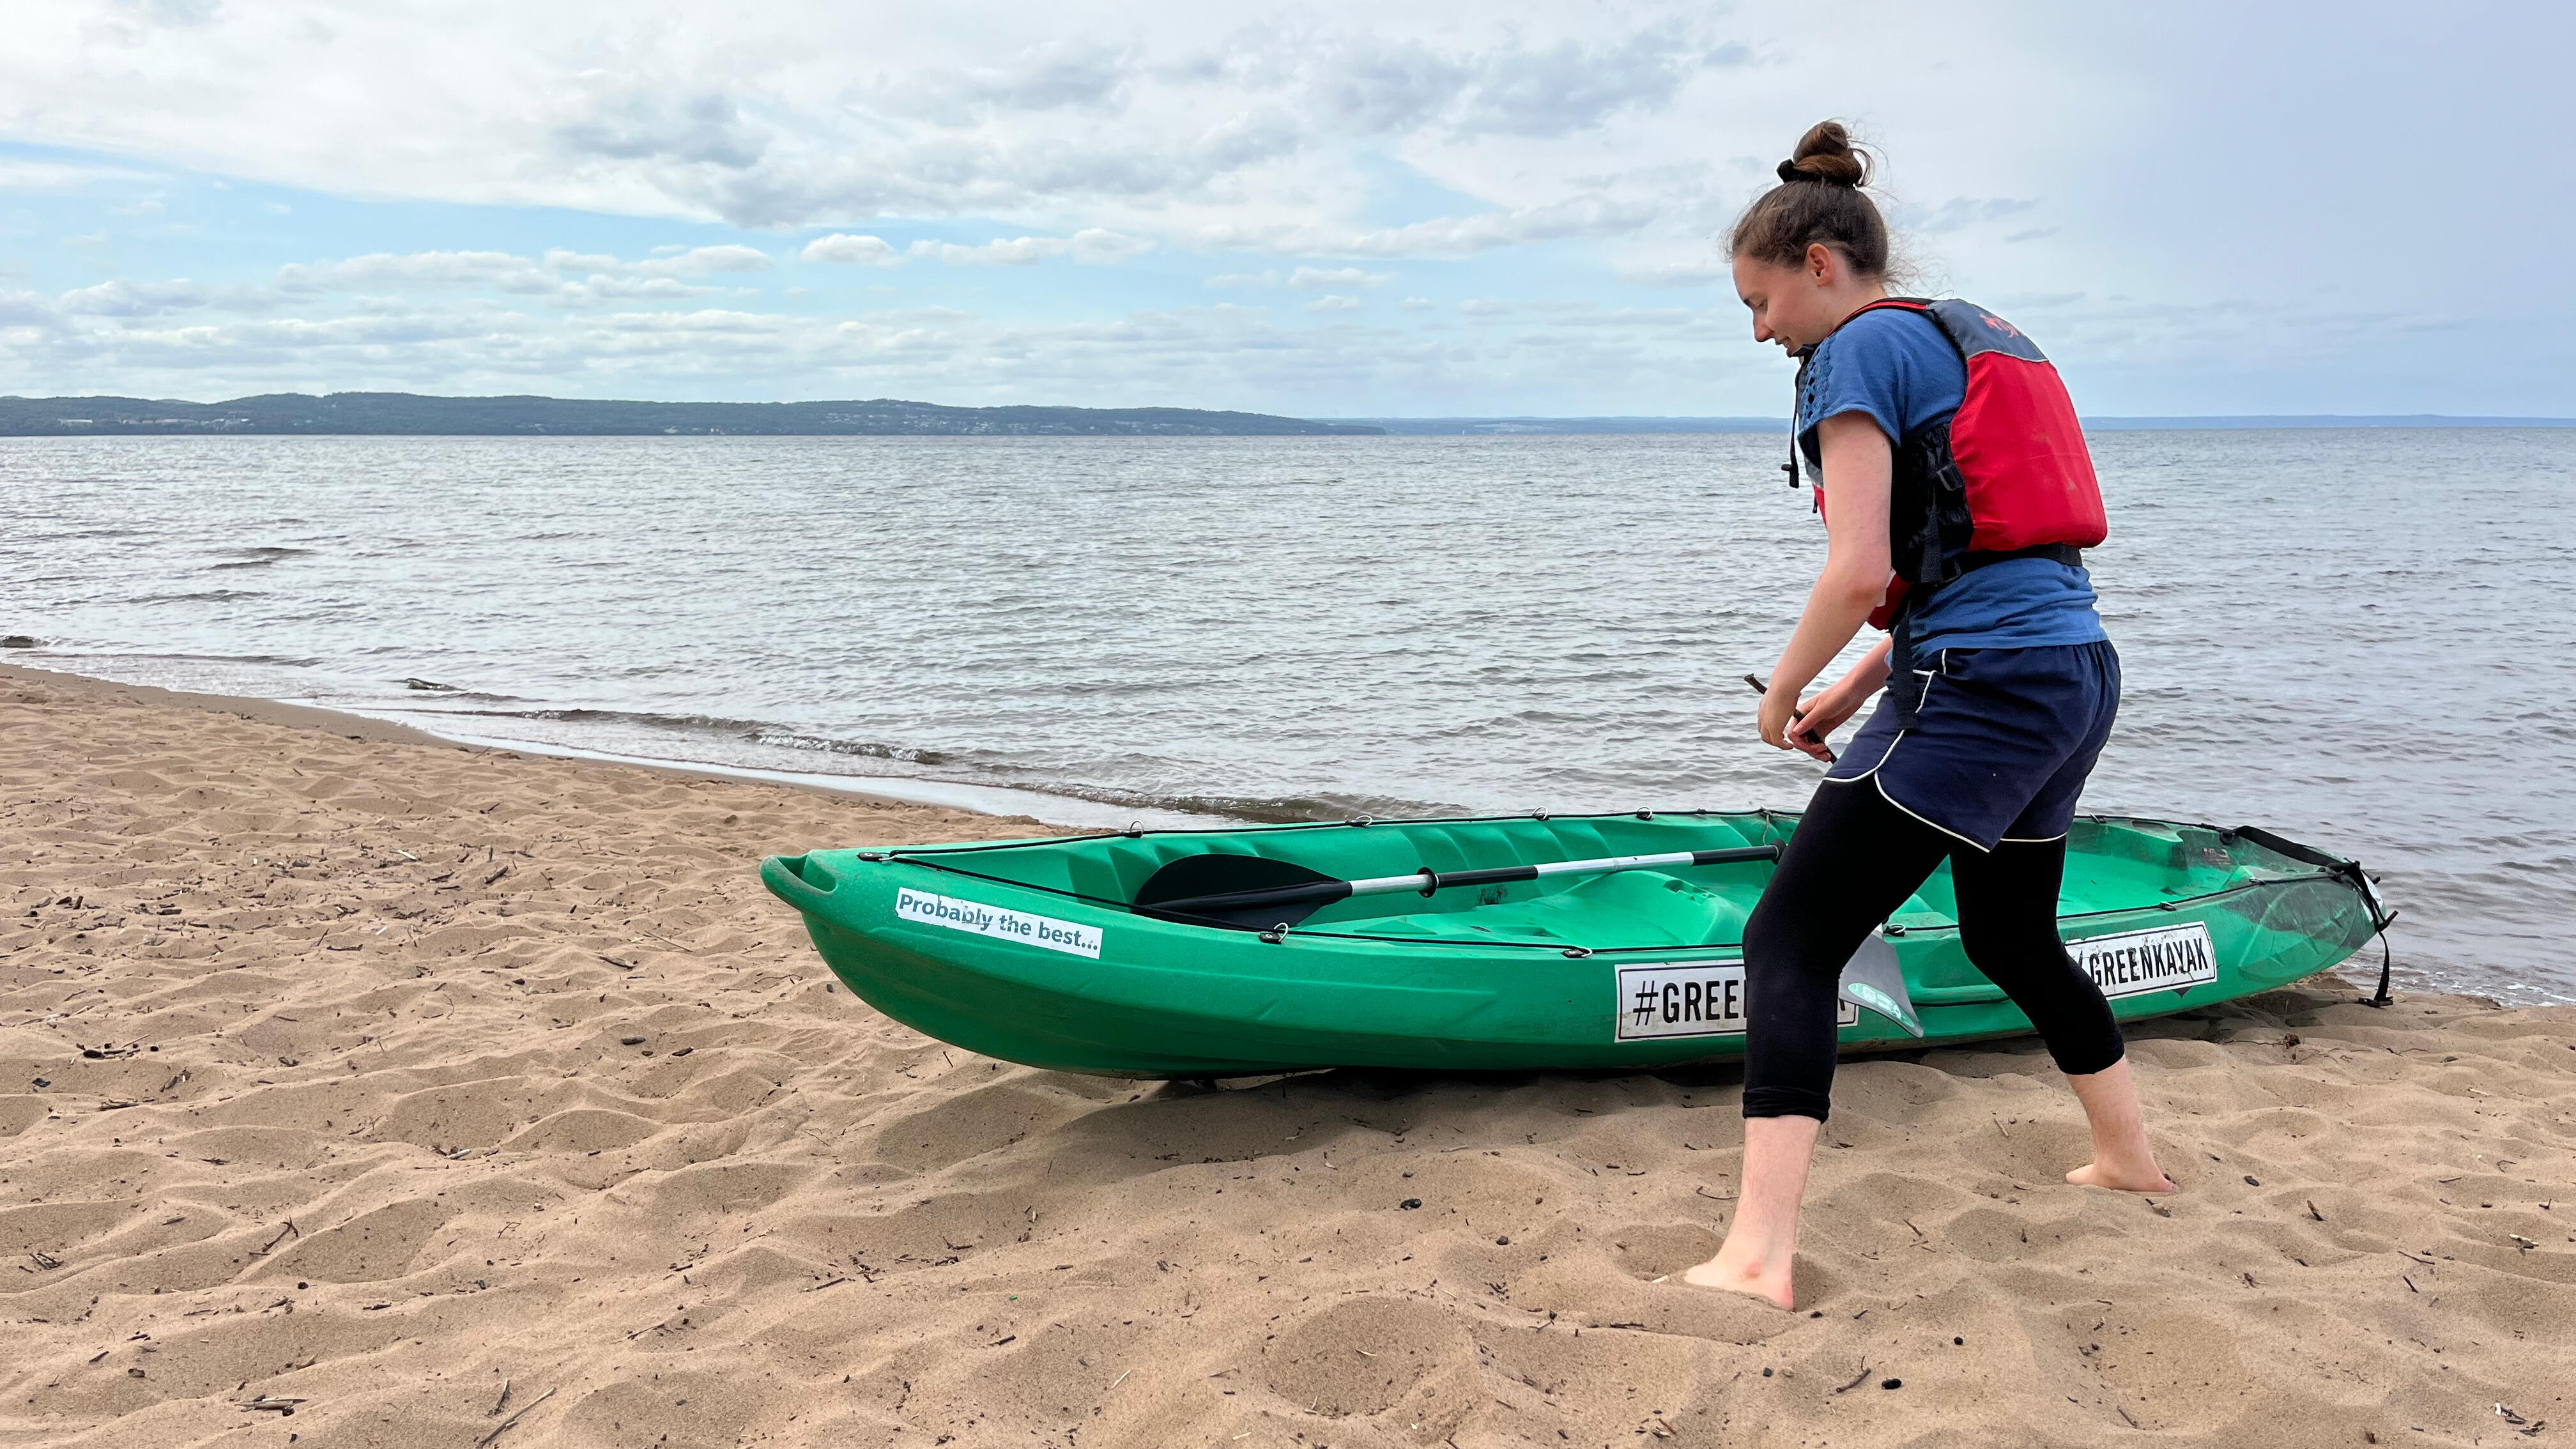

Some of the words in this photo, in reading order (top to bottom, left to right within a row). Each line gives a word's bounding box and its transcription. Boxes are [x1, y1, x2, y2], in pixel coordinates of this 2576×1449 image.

[898, 893, 993, 931] Probably
[999, 914, 1032, 936] the
[1038, 921, 1099, 951] best...
[1632, 979, 1747, 1026] #GREE
